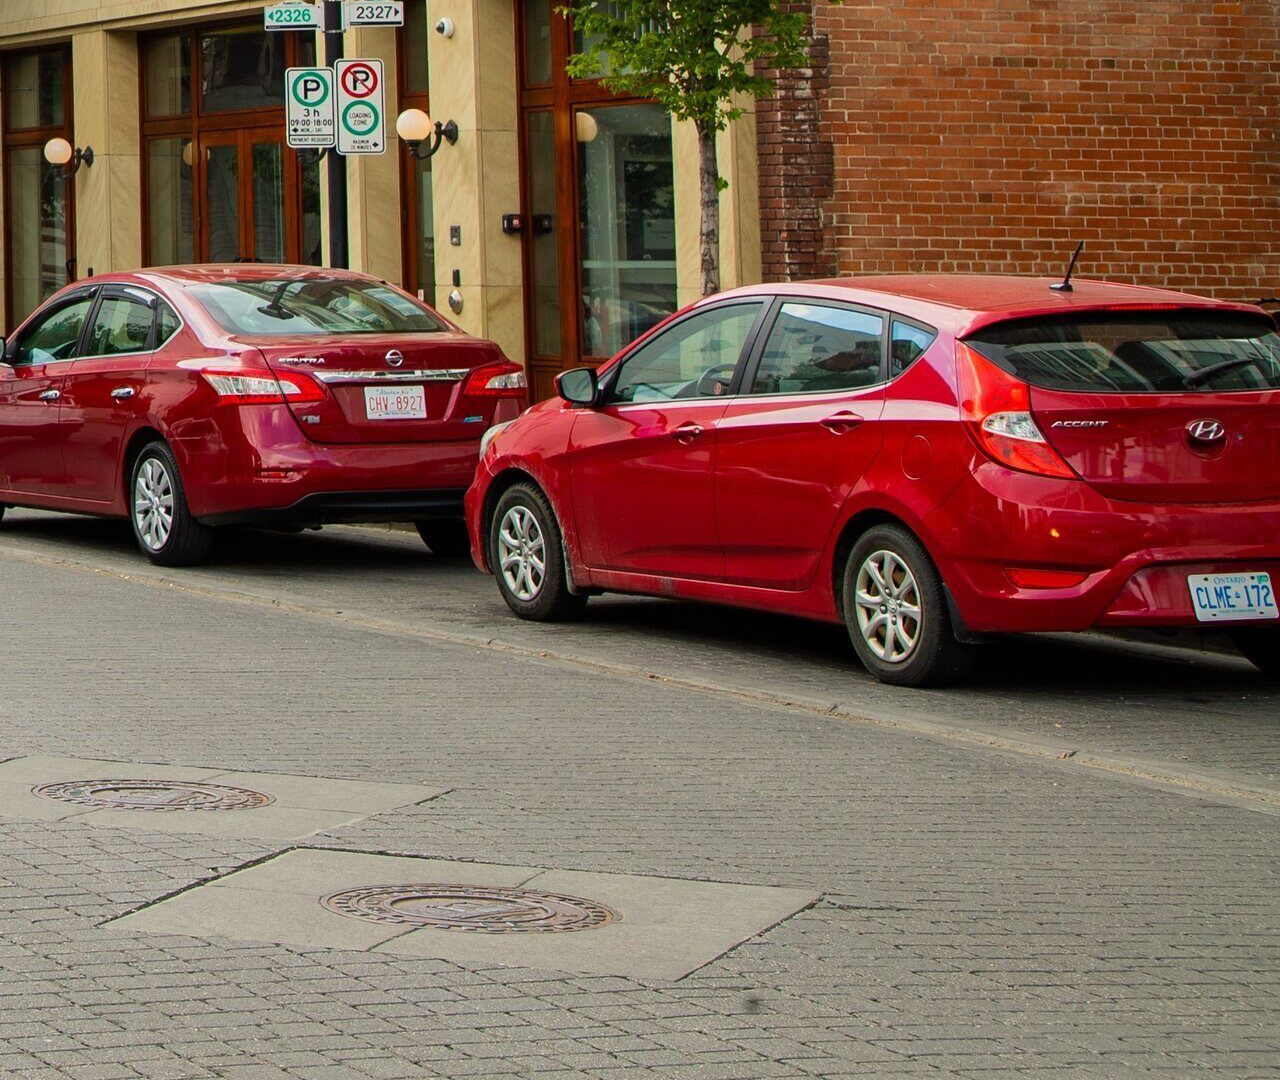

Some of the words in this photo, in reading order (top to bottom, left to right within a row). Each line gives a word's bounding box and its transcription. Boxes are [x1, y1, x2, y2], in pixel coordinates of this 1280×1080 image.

[275, 9, 311, 23] 2326
[356, 6, 392, 19] 2327
[303, 108, 310, 117] 3
[313, 108, 320, 117] h
[368, 395, 423, 412] CHV-8927
[1051, 420, 1108, 428] ACCENT
[1196, 585, 1236, 609] CLME
[1243, 584, 1274, 608] 172
